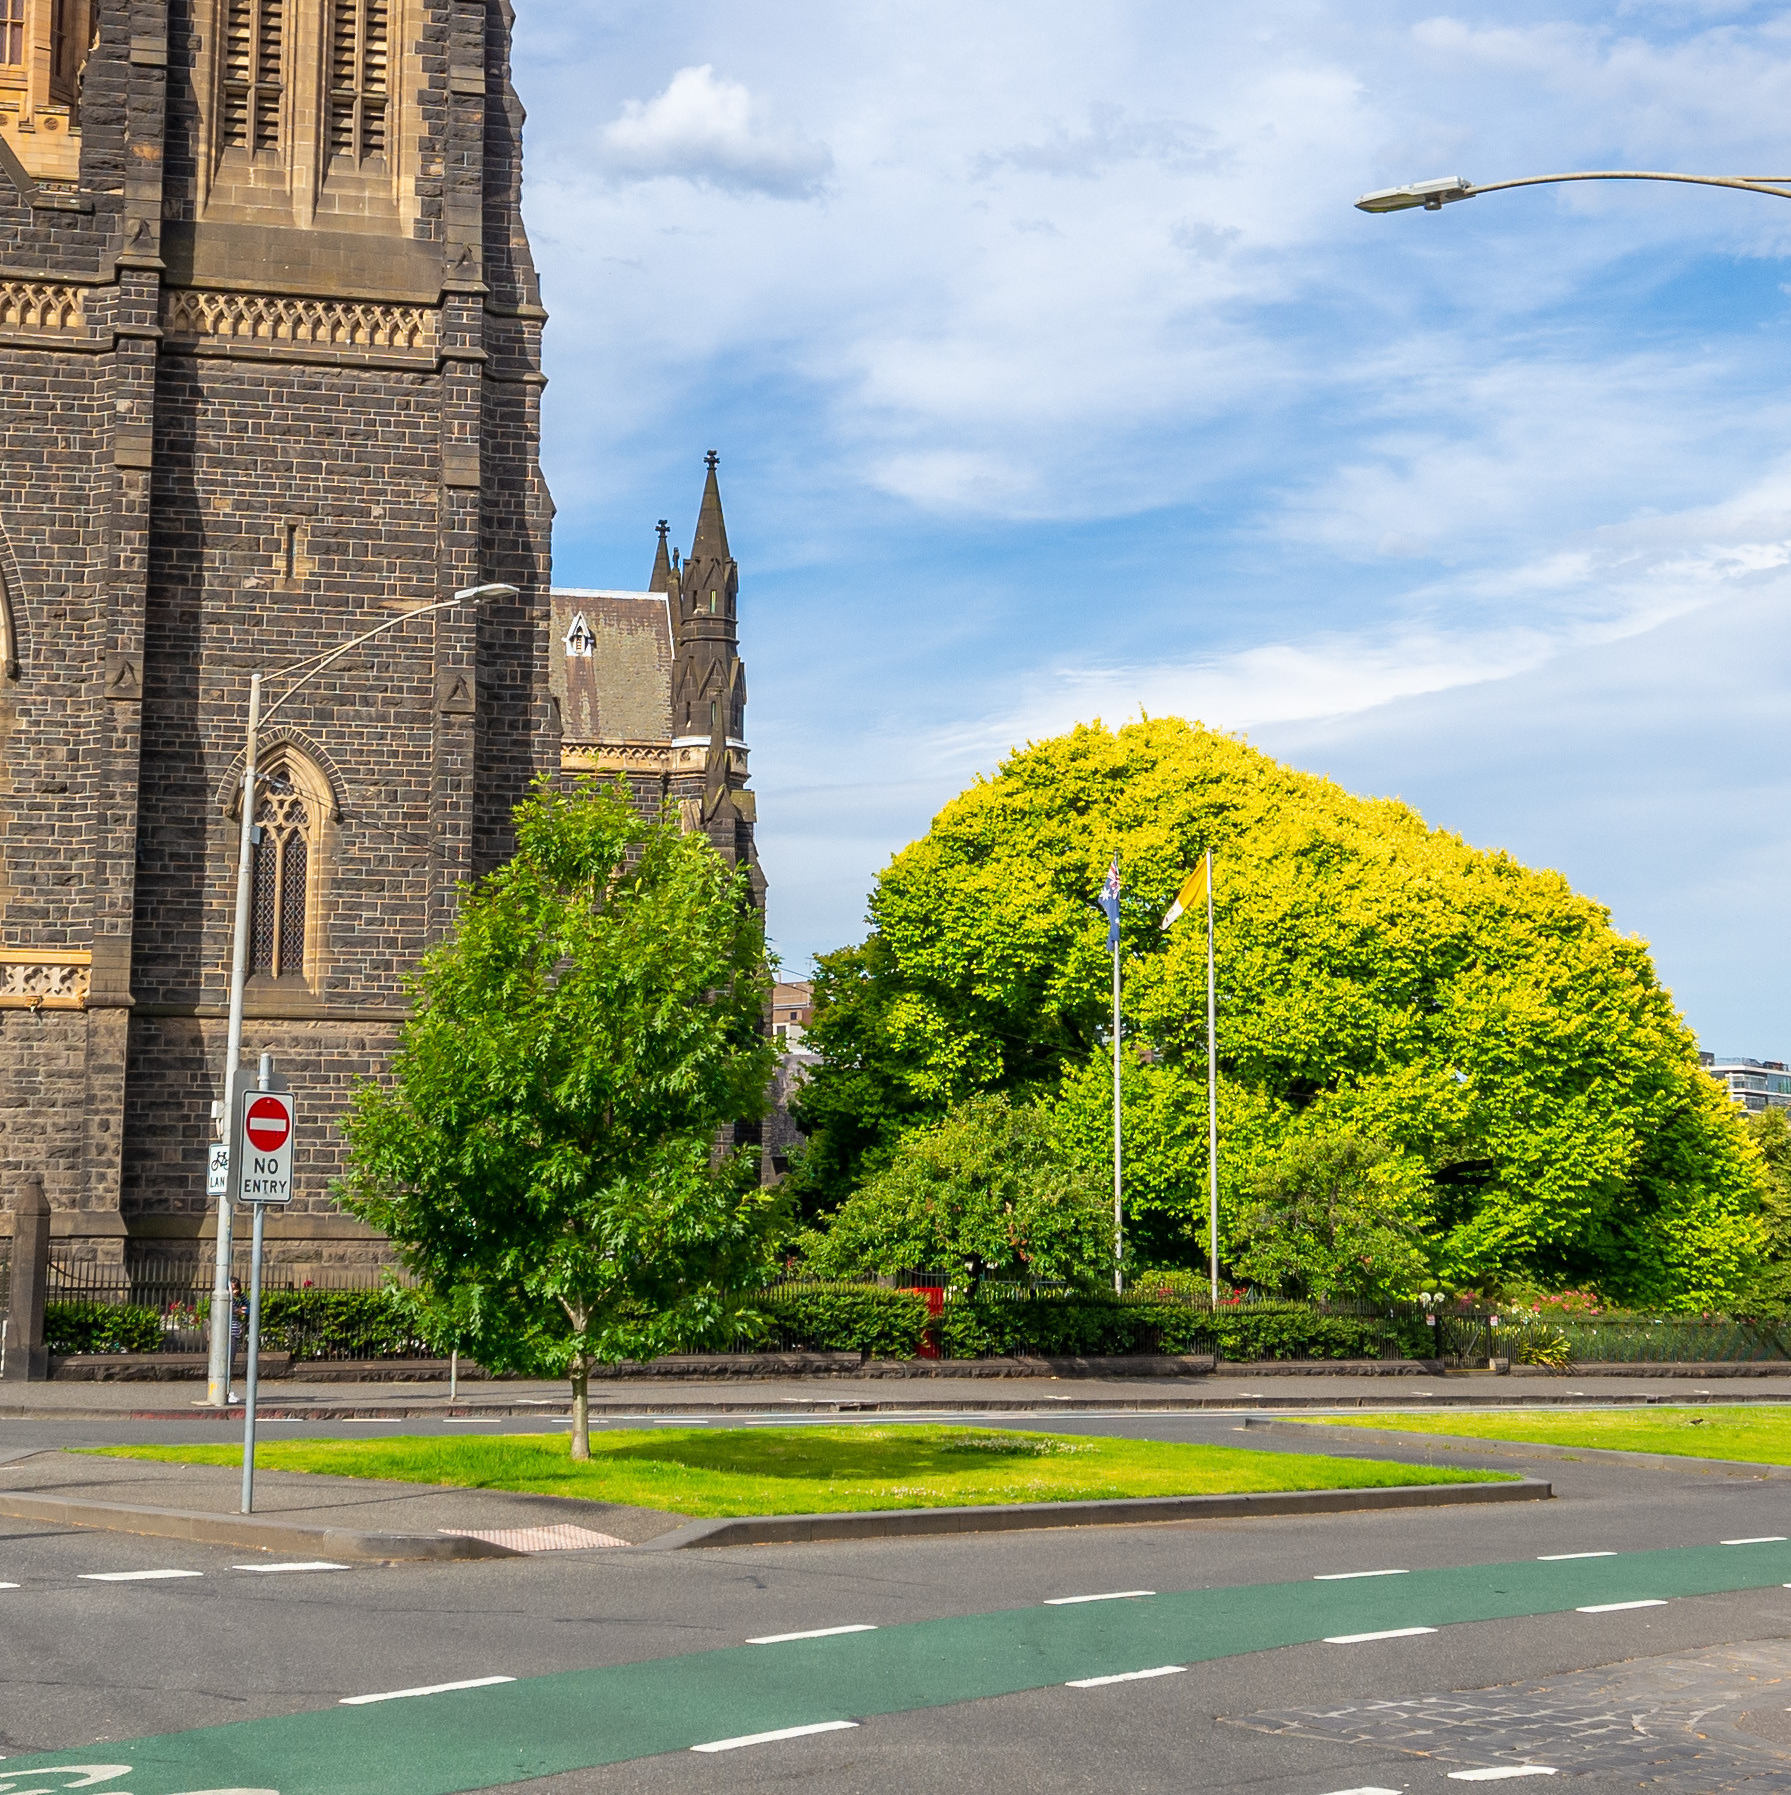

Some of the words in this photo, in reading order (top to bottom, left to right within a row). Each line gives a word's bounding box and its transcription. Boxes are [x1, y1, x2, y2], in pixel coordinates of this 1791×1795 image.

[254, 1157, 278, 1175] NO
[210, 1176, 226, 1188] LAN
[244, 1179, 287, 1194] ENTRY
